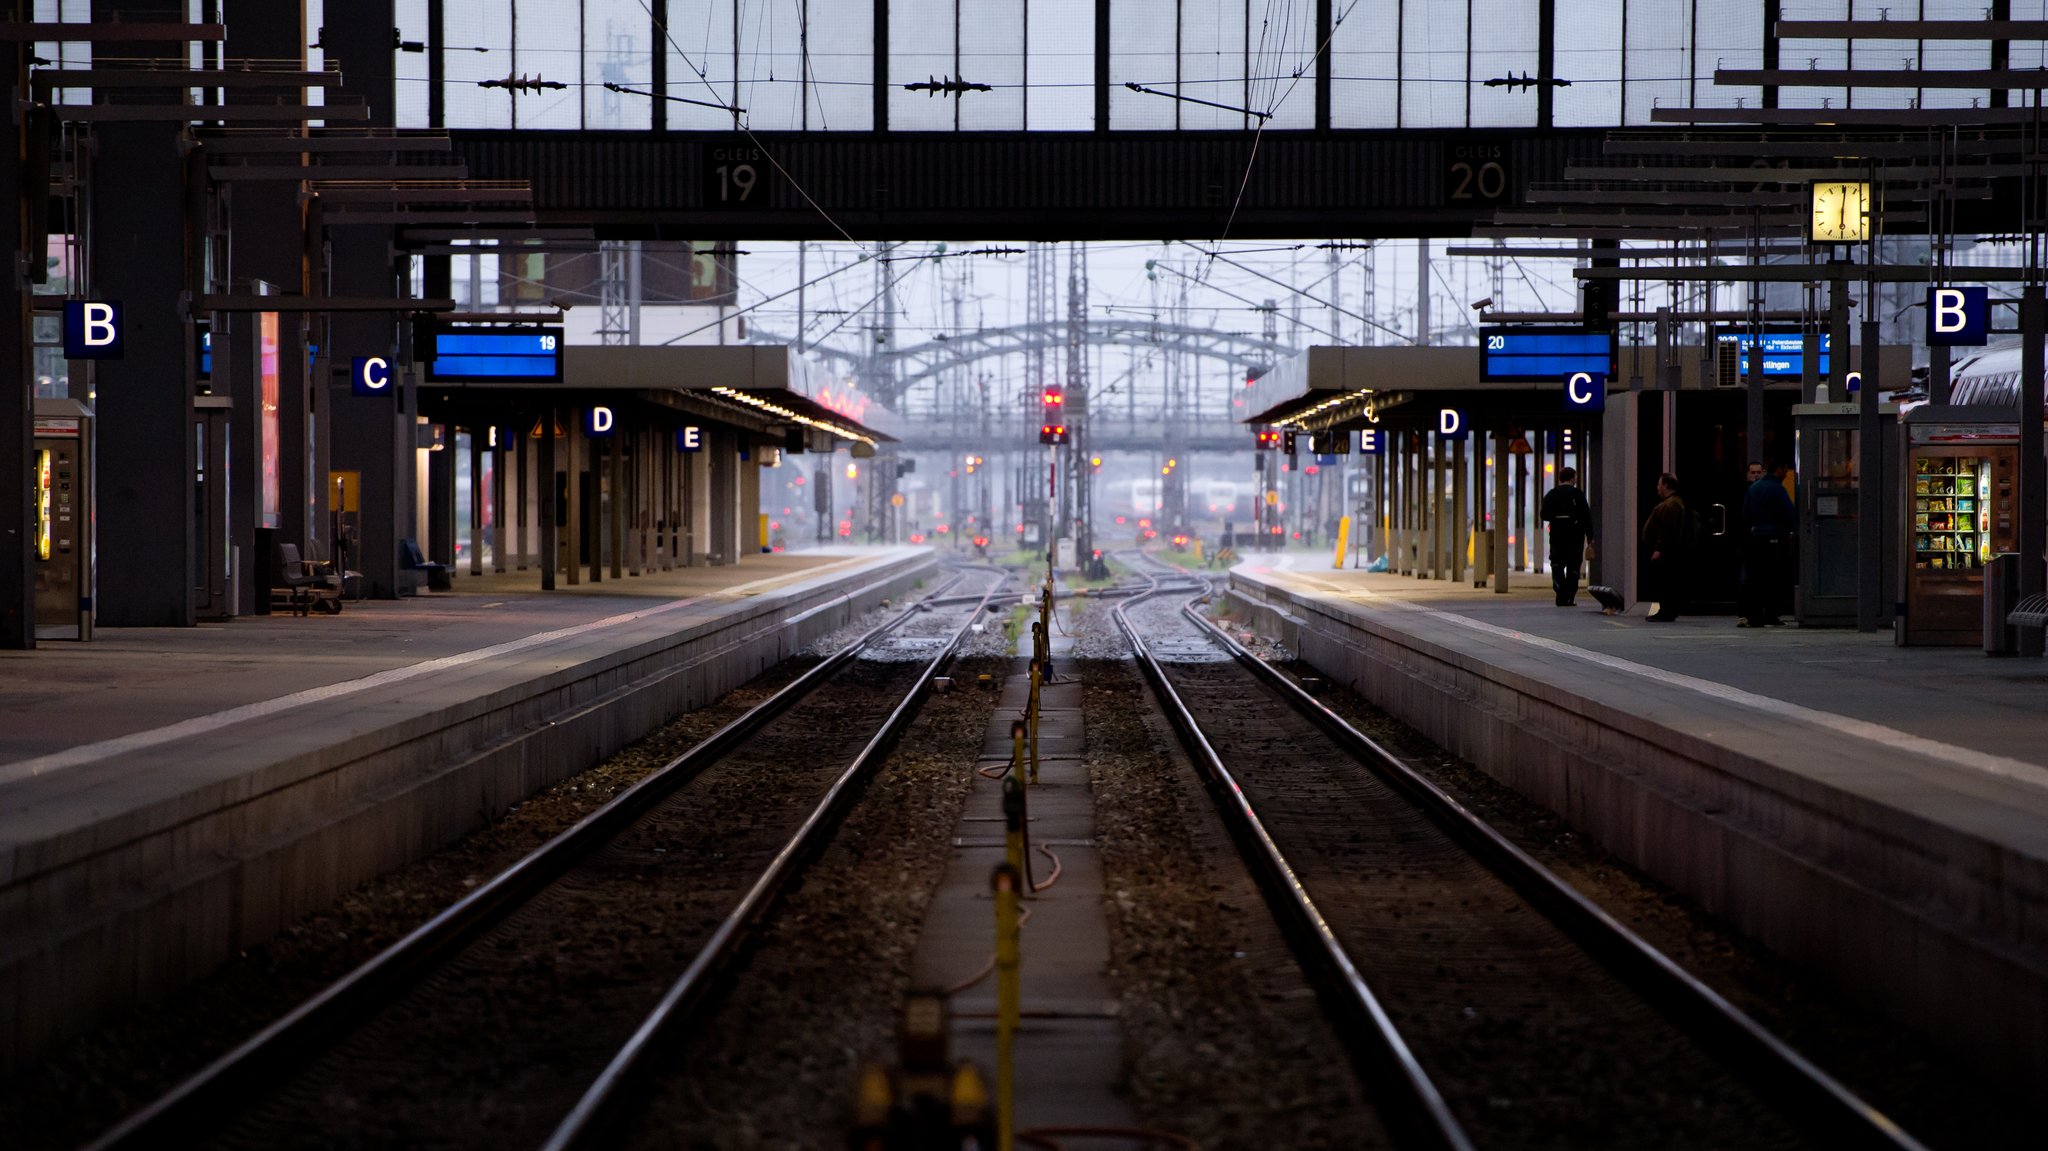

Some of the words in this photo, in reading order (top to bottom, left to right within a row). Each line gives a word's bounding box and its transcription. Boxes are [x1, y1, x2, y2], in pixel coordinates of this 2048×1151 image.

[714, 148, 760, 160] GLEIS
[1455, 146, 1501, 158] GLEIS
[716, 164, 757, 201] 19
[1450, 162, 1505, 199] 20
[1935, 289, 1967, 333] B
[84, 303, 116, 346] B
[539, 336, 556, 350] 19
[1488, 335, 1505, 349] 20
[363, 357, 388, 389] C
[1569, 372, 1592, 404] C
[593, 406, 613, 432] D
[1440, 409, 1460, 434] D
[684, 426, 700, 448] E
[1361, 429, 1376, 450] E
